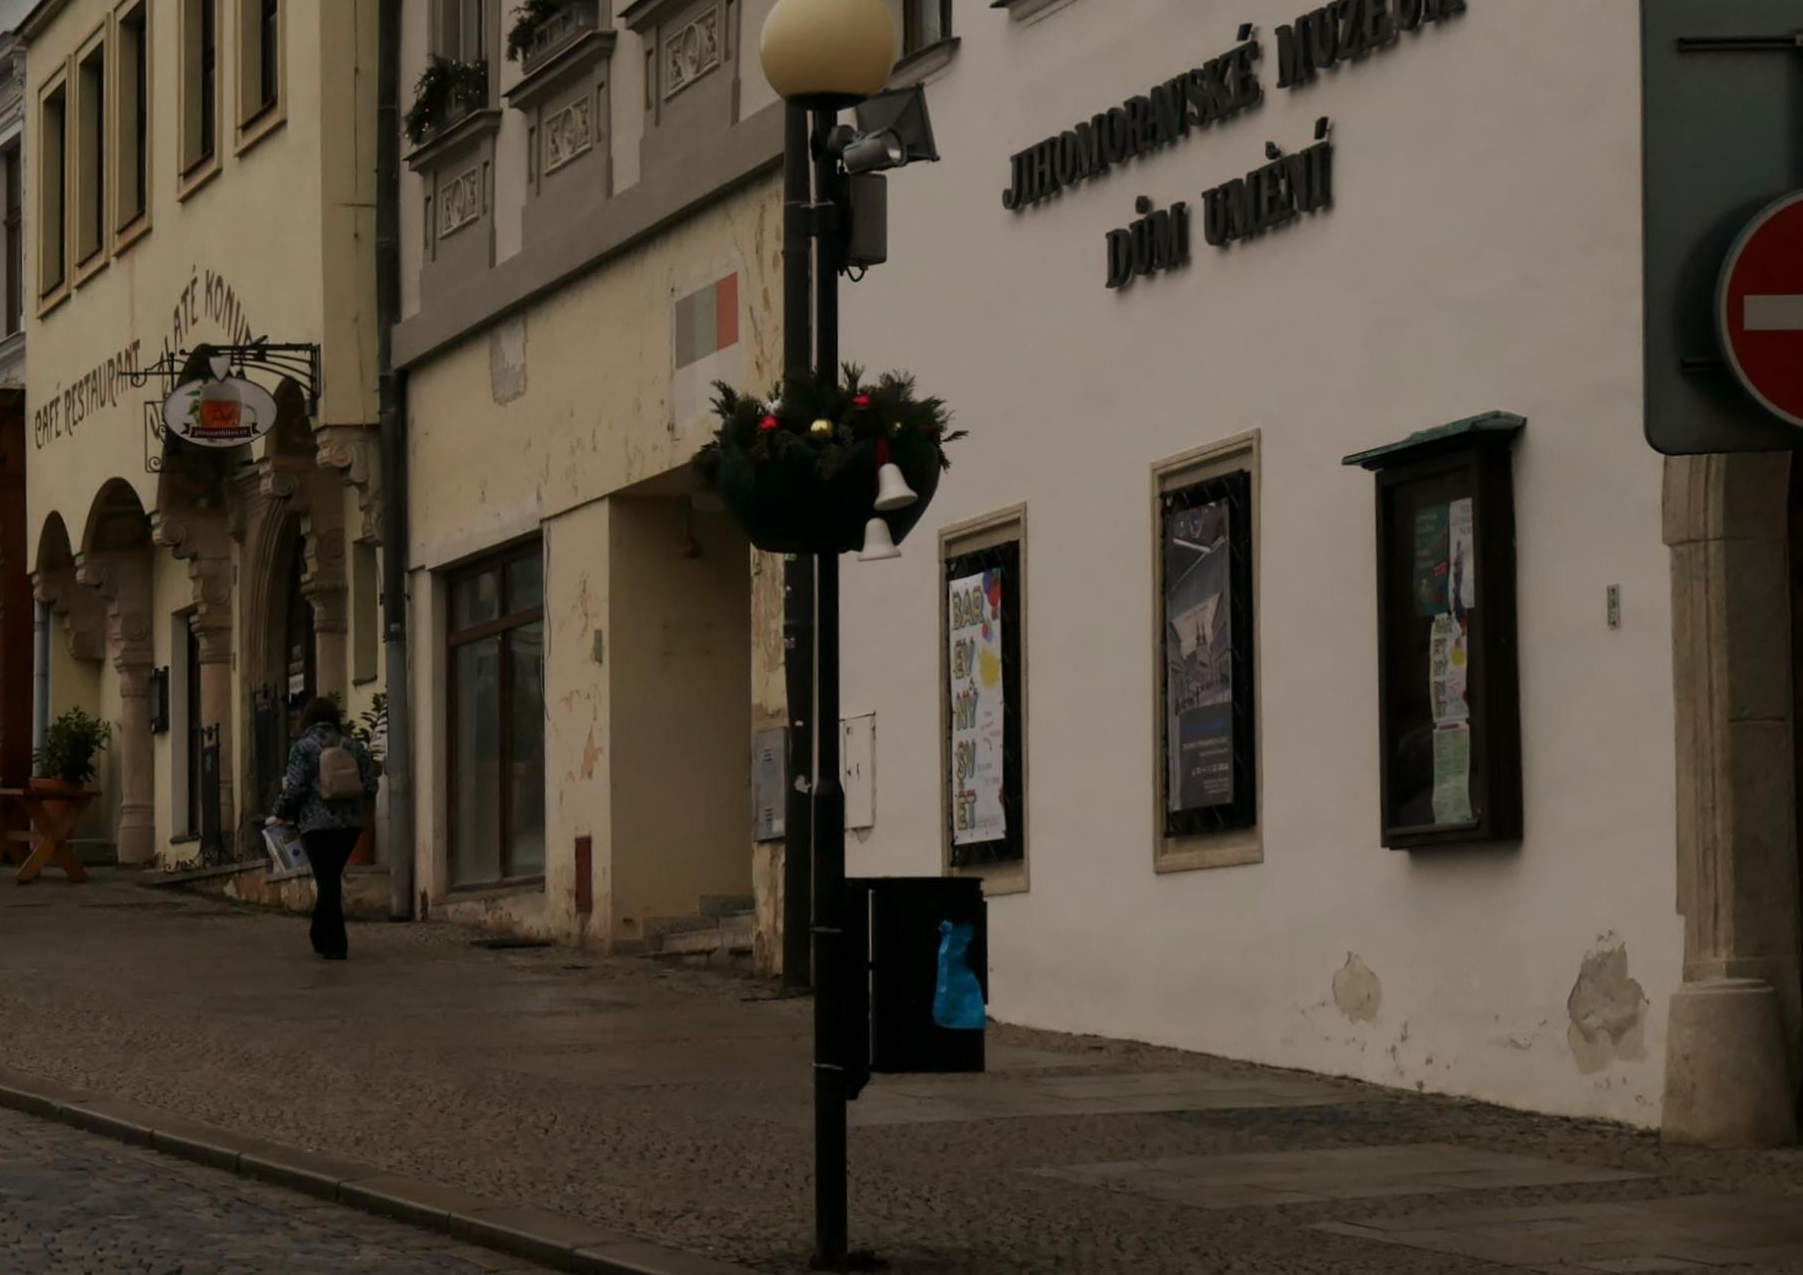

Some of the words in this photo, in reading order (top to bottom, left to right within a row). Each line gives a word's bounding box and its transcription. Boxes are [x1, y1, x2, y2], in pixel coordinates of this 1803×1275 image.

[1002, 23, 1264, 209] JIHOMORAVSKÉ
[1106, 196, 1190, 288] DŮM
[1202, 117, 1333, 246] UMĚNÍ
[34, 381, 61, 450] CAFÉ
[64, 339, 141, 437] RESTAURANT
[951, 585, 985, 631] BAR
[954, 635, 976, 679] EV
[955, 677, 979, 731] NÝ
